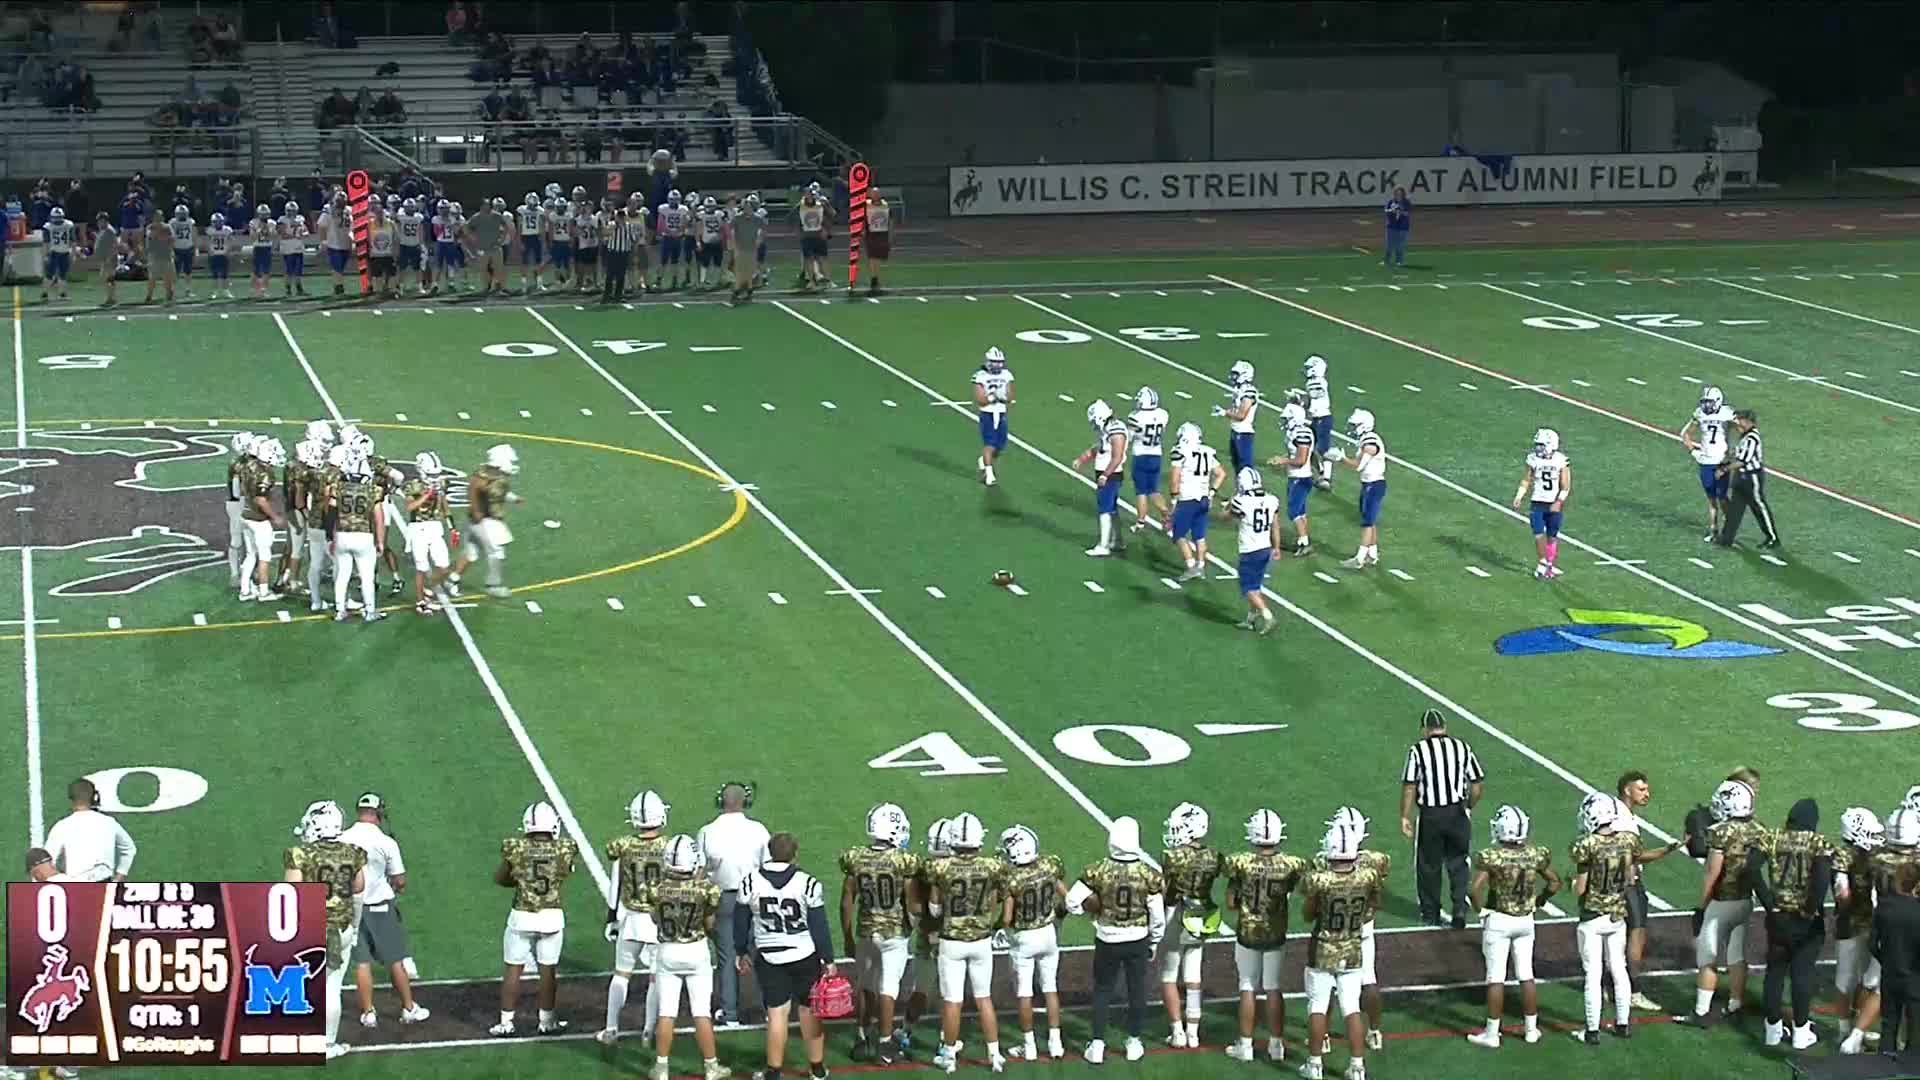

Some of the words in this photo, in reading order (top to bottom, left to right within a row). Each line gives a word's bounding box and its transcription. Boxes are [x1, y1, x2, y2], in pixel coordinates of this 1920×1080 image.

[998, 175, 1108, 202] WILLIS
[1120, 175, 1149, 200] C.
[1160, 171, 1279, 199] STREIN
[1290, 169, 1397, 196] TRACK
[1409, 169, 1449, 193] AT
[1457, 166, 1578, 193] ALUMNI
[1590, 164, 1678, 190] FIELD
[1706, 425, 1718, 445] 7
[1191, 451, 1210, 477] 71
[1541, 471, 1552, 492] 5
[341, 495, 366, 515] 56
[1252, 508, 1271, 534] 61
[531, 859, 551, 896] 5
[949, 878, 990, 916] 27
[1114, 885, 1132, 921] 9
[1328, 896, 1366, 931] 62
[658, 900, 698, 938] 67
[758, 896, 809, 935] 52
